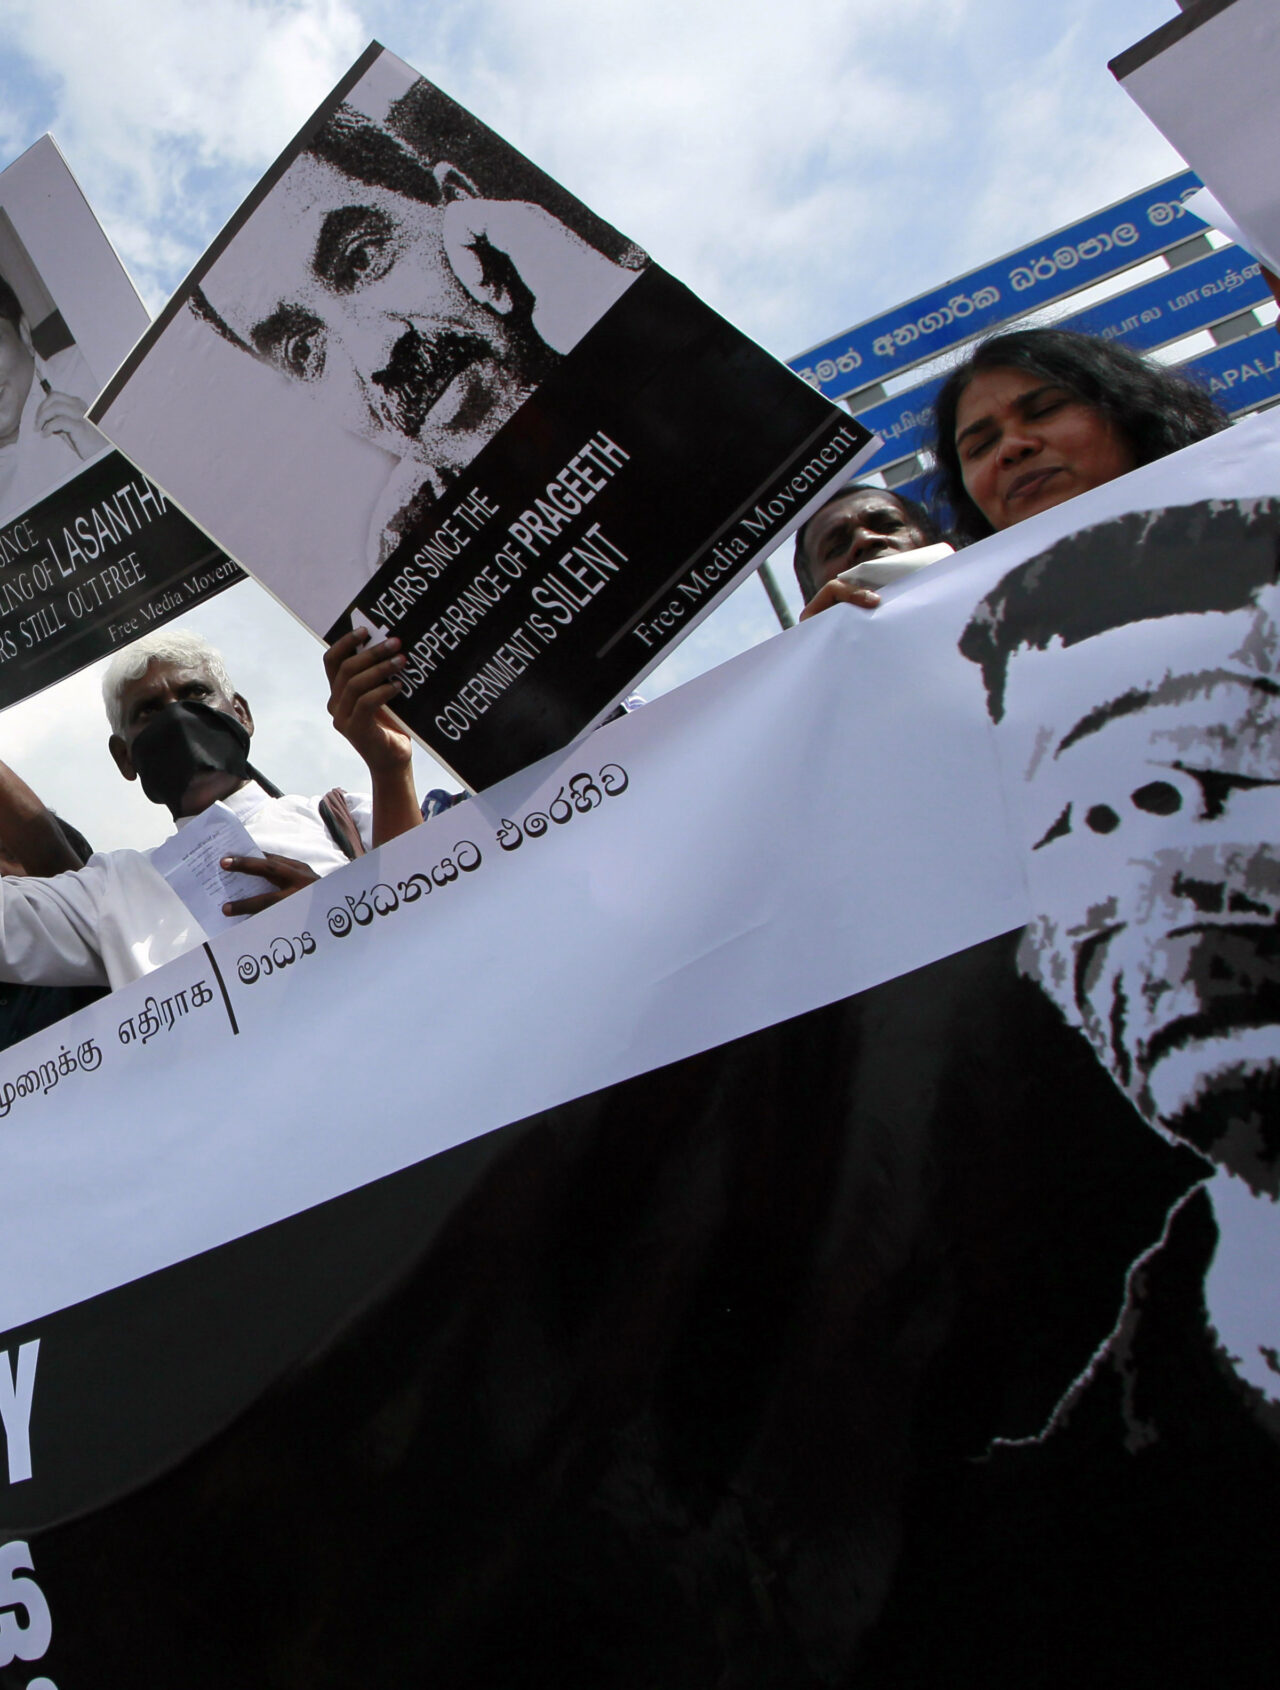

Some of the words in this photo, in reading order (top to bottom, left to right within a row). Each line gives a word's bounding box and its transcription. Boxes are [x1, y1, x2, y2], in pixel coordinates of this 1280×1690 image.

[418, 519, 472, 578] SINCE
[453, 488, 499, 530] THE
[509, 432, 629, 556] PRAGEETH
[632, 599, 686, 648] Free
[677, 537, 749, 602] Media
[738, 425, 858, 532] Movement
[20, 604, 66, 647] STILL
[68, 578, 102, 618] OUT
[101, 552, 146, 599] FREE
[33, 562, 53, 591] OF
[496, 541, 528, 590] OF
[532, 523, 627, 623] SILENT
[107, 614, 139, 643] Free
[140, 589, 184, 624] Media
[390, 565, 517, 698] DISAPPEARANCE
[523, 611, 558, 645] IS
[436, 623, 548, 740] GOVERNMENT
